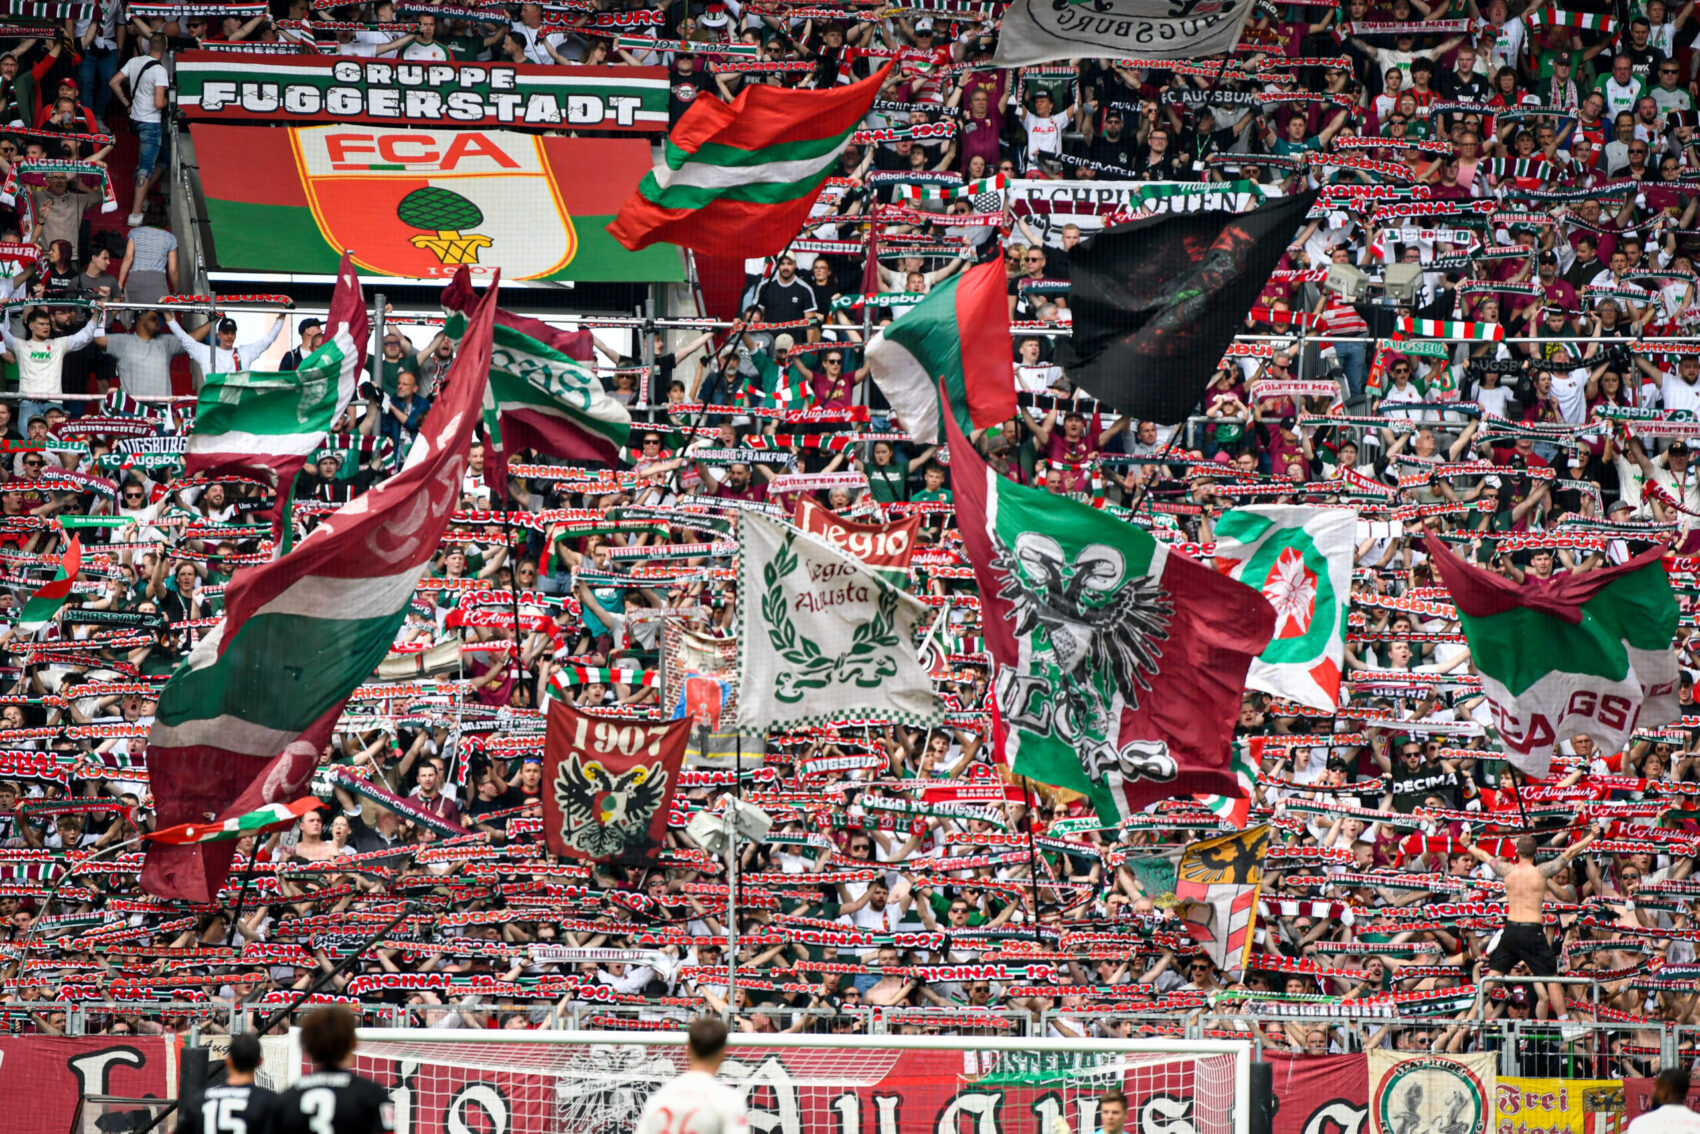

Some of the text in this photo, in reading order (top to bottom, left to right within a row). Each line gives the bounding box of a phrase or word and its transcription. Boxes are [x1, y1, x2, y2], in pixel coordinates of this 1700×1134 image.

[333, 60, 516, 89] GRUPPE
[200, 80, 642, 126] FUGGERSTADT
[911, 121, 957, 138] 1907
[325, 132, 521, 170] FCA
[19, 158, 92, 168] AUGSBURG
[855, 293, 925, 308] Augsbu
[30, 351, 51, 360] WWK
[1383, 339, 1444, 355] AUGSBU
[118, 436, 188, 454] AUGSBURG
[102, 453, 180, 469] FC Augsbu
[507, 464, 591, 481] ORIGINAL
[801, 501, 910, 558] Legio
[110, 636, 152, 648] 1907
[64, 681, 155, 699] ORIGINAL
[572, 716, 671, 757] 1907
[1393, 772, 1459, 794] DECIMA
[1536, 783, 1598, 801] Augsburg
[1619, 821, 1638, 837] FC
[416, 844, 542, 862] ORIGINAL 1907
[158, 917, 197, 932] 1907
[382, 940, 469, 954] ORIGINAL
[480, 946, 522, 956] 1907
[892, 931, 945, 949] 1907
[105, 944, 233, 957] AUGSBURG
[109, 972, 264, 988] AUGSBURG
[1008, 985, 1105, 997] ORIGINAL
[660, 997, 704, 1007] 1907
[1395, 1059, 1424, 1076] STAY
[1496, 1083, 1570, 1116] Frei
[201, 1098, 249, 1134] 15
[299, 1085, 338, 1134] 3
